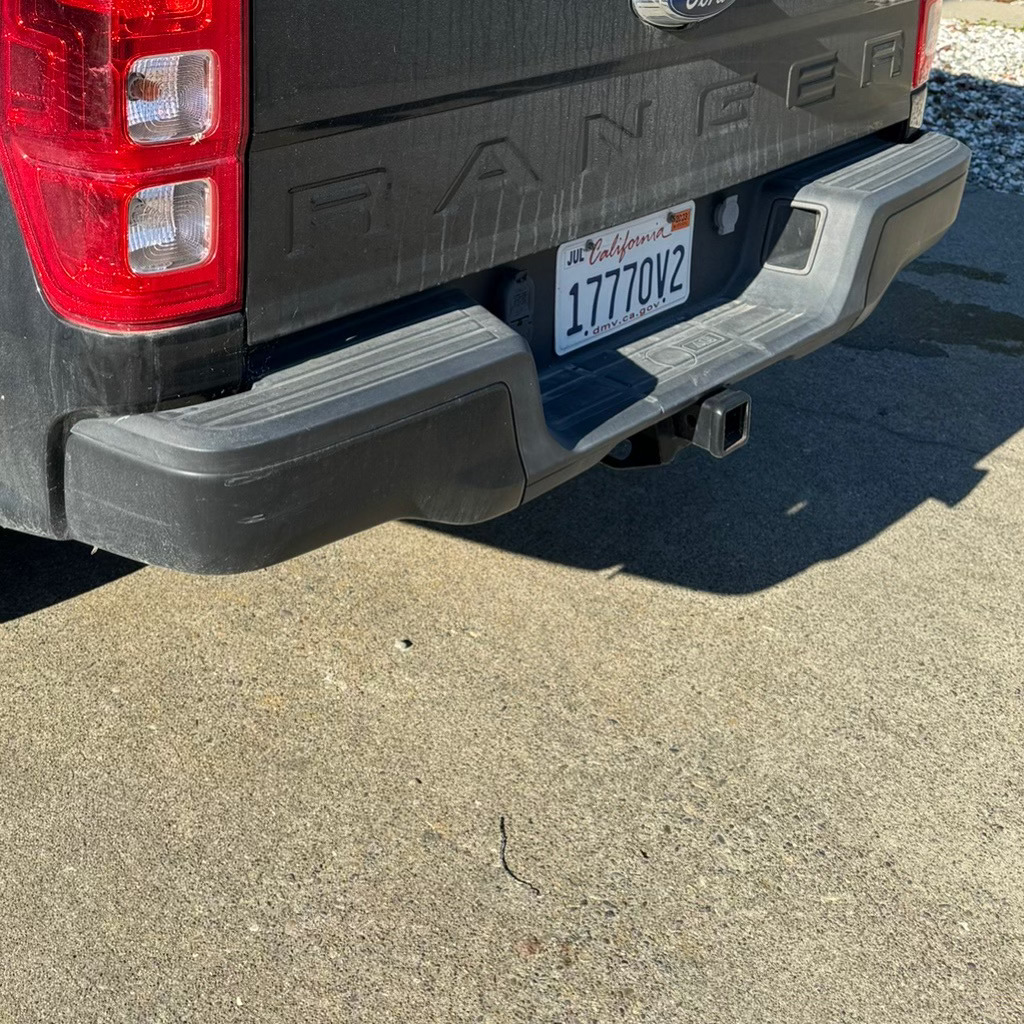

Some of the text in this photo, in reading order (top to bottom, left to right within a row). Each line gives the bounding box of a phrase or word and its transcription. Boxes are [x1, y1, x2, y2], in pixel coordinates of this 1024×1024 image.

[286, 29, 905, 260] RANGER
[567, 222, 672, 266] JUL California
[566, 244, 686, 337] 17770V2
[592, 302, 660, 335] dmv.ca.gov
